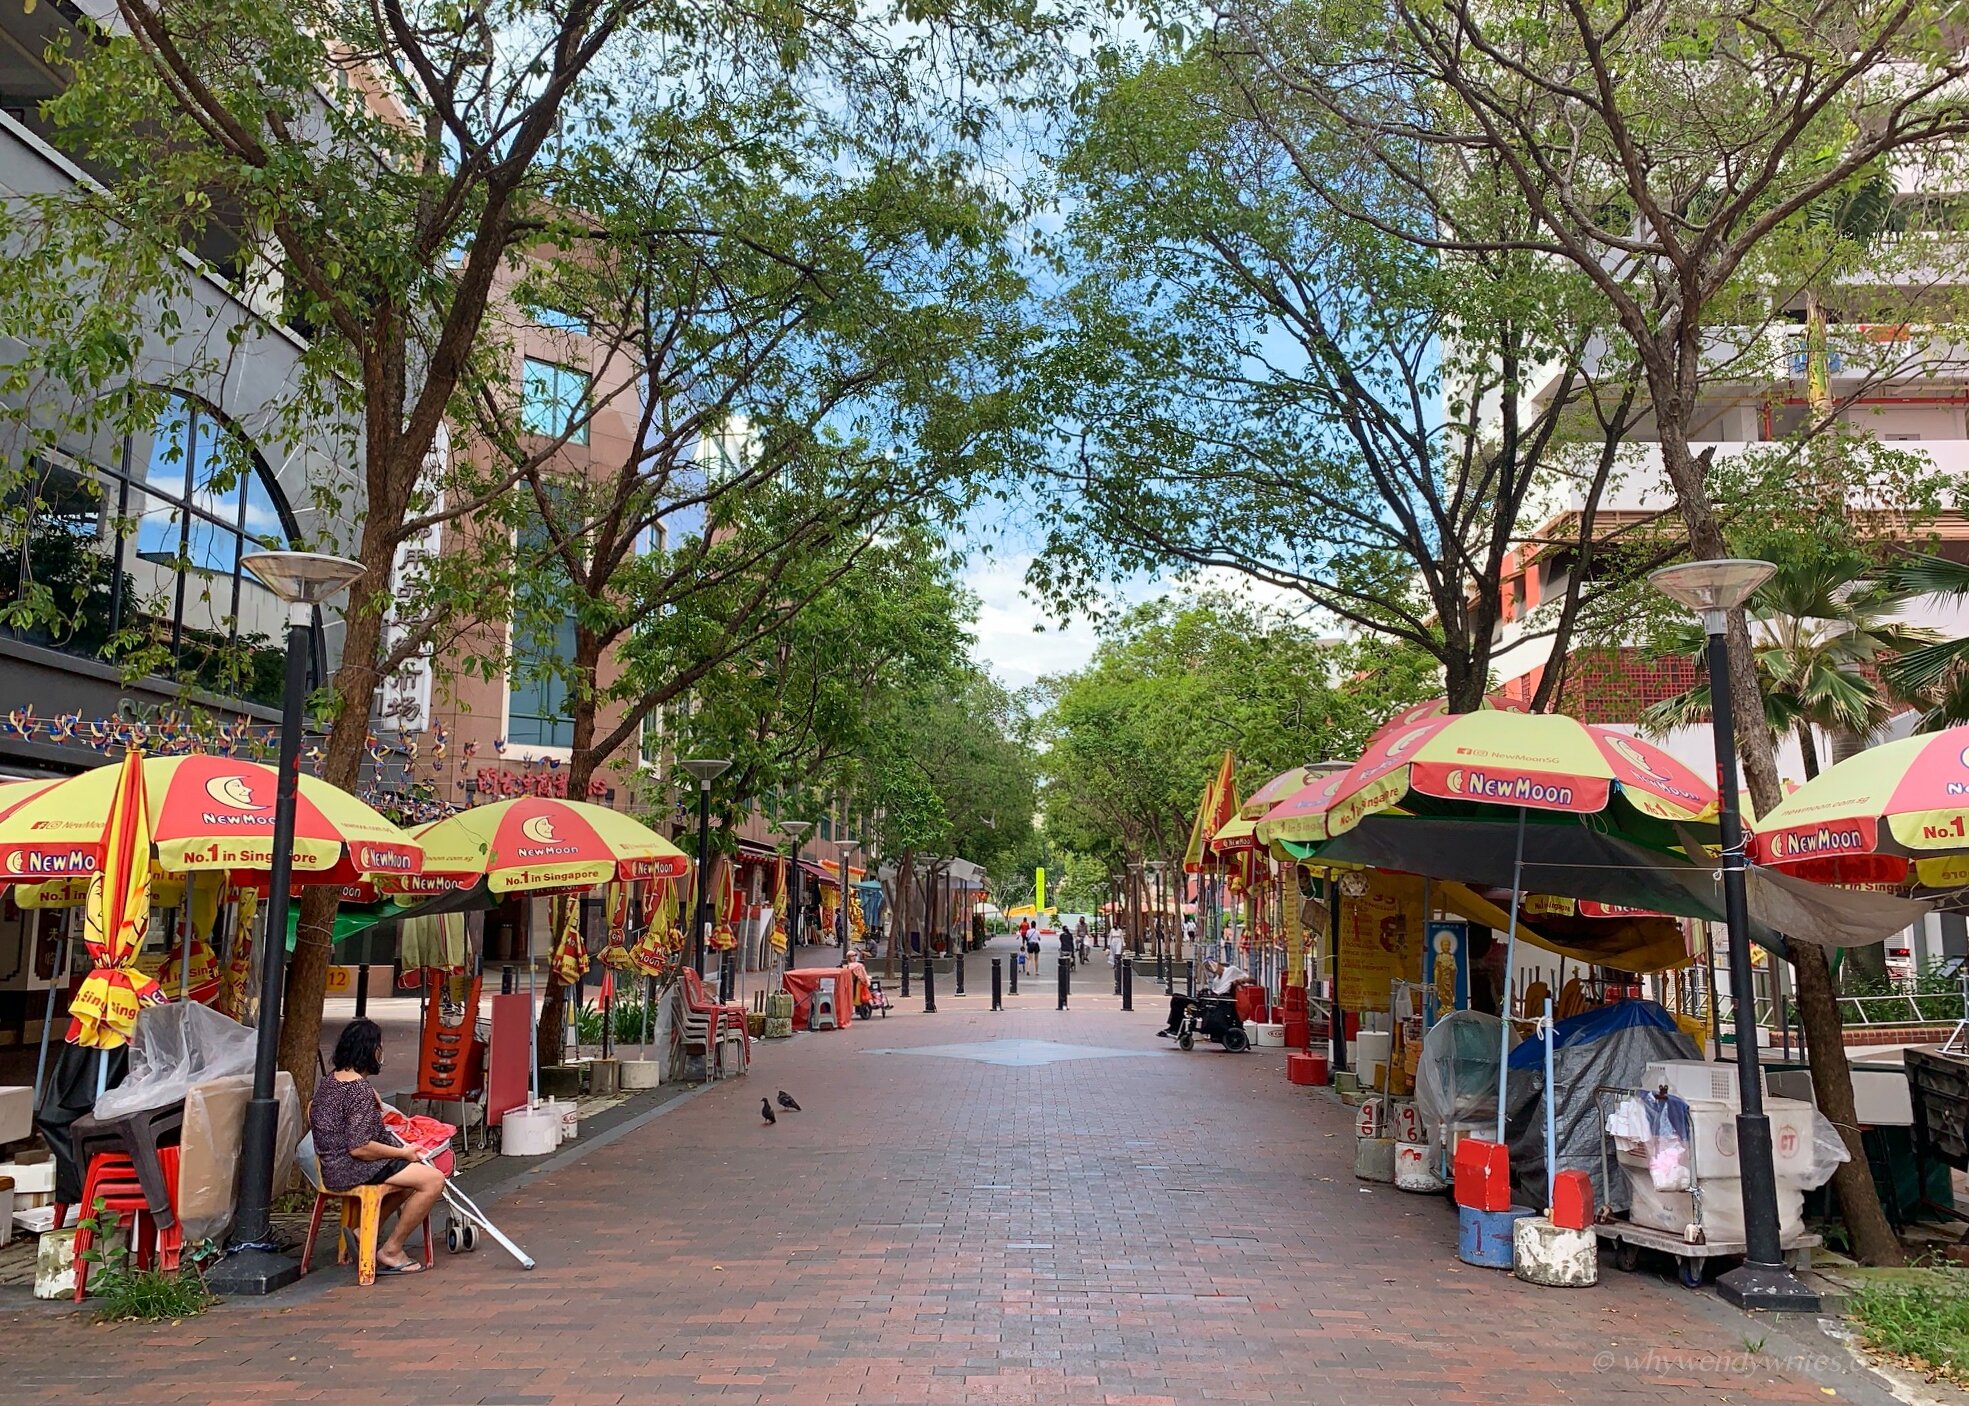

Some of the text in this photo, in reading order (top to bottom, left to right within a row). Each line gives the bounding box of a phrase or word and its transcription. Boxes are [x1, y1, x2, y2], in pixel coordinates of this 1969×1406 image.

[1491, 752, 1559, 763] NewMoonSG
[1468, 772, 1573, 804] NewMoon
[1923, 815, 1965, 839] No.1
[1787, 828, 1862, 855] NewMoon
[184, 843, 317, 864] No.1 in Singore
[517, 846, 579, 858] NewMoon
[505, 870, 599, 886] No.1 in Singapore
[40, 885, 70, 902] No.1
[328, 971, 346, 985] 12
